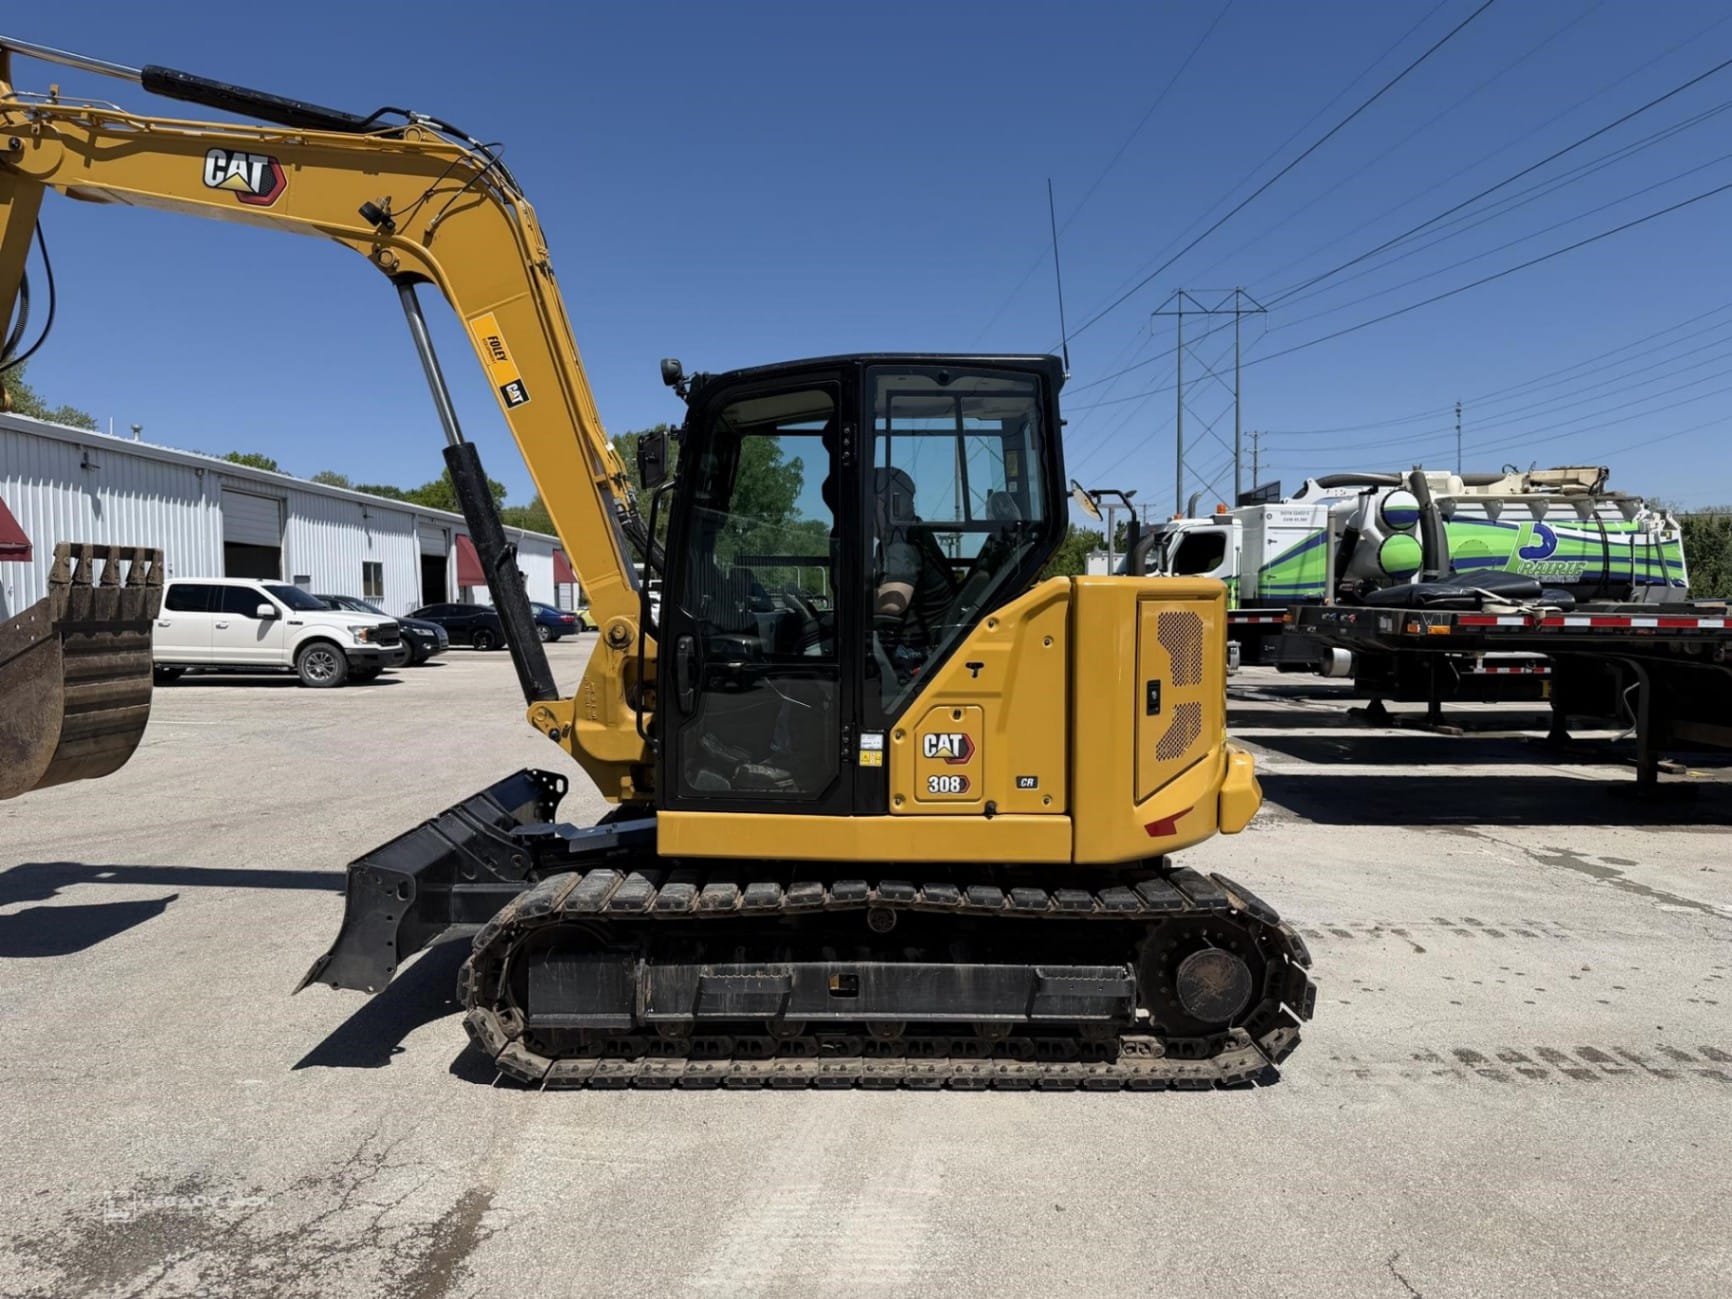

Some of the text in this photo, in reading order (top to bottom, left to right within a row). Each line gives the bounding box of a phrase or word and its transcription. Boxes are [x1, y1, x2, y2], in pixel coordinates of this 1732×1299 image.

[204, 149, 269, 193] CAT
[487, 335, 508, 361] FOLEY
[505, 383, 525, 404] CAT
[923, 733, 963, 758] CAT
[928, 775, 961, 793] 308
